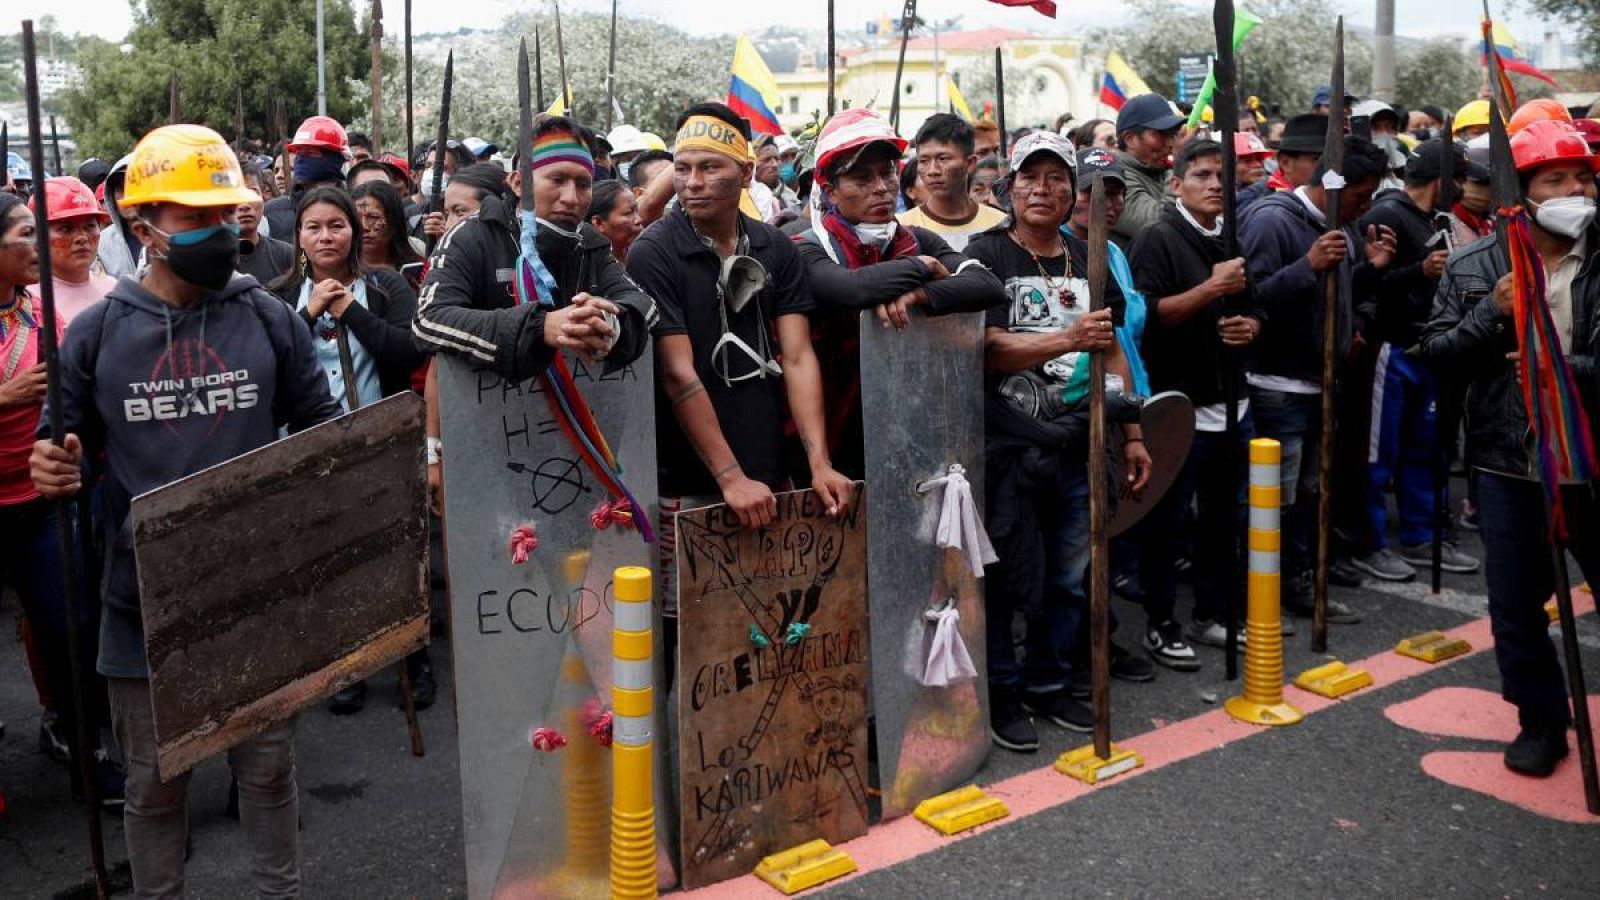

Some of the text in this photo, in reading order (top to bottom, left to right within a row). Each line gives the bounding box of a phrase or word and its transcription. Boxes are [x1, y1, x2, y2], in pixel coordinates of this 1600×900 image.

[128, 369, 248, 394] TWIN BORO
[123, 384, 259, 422] BEARS
